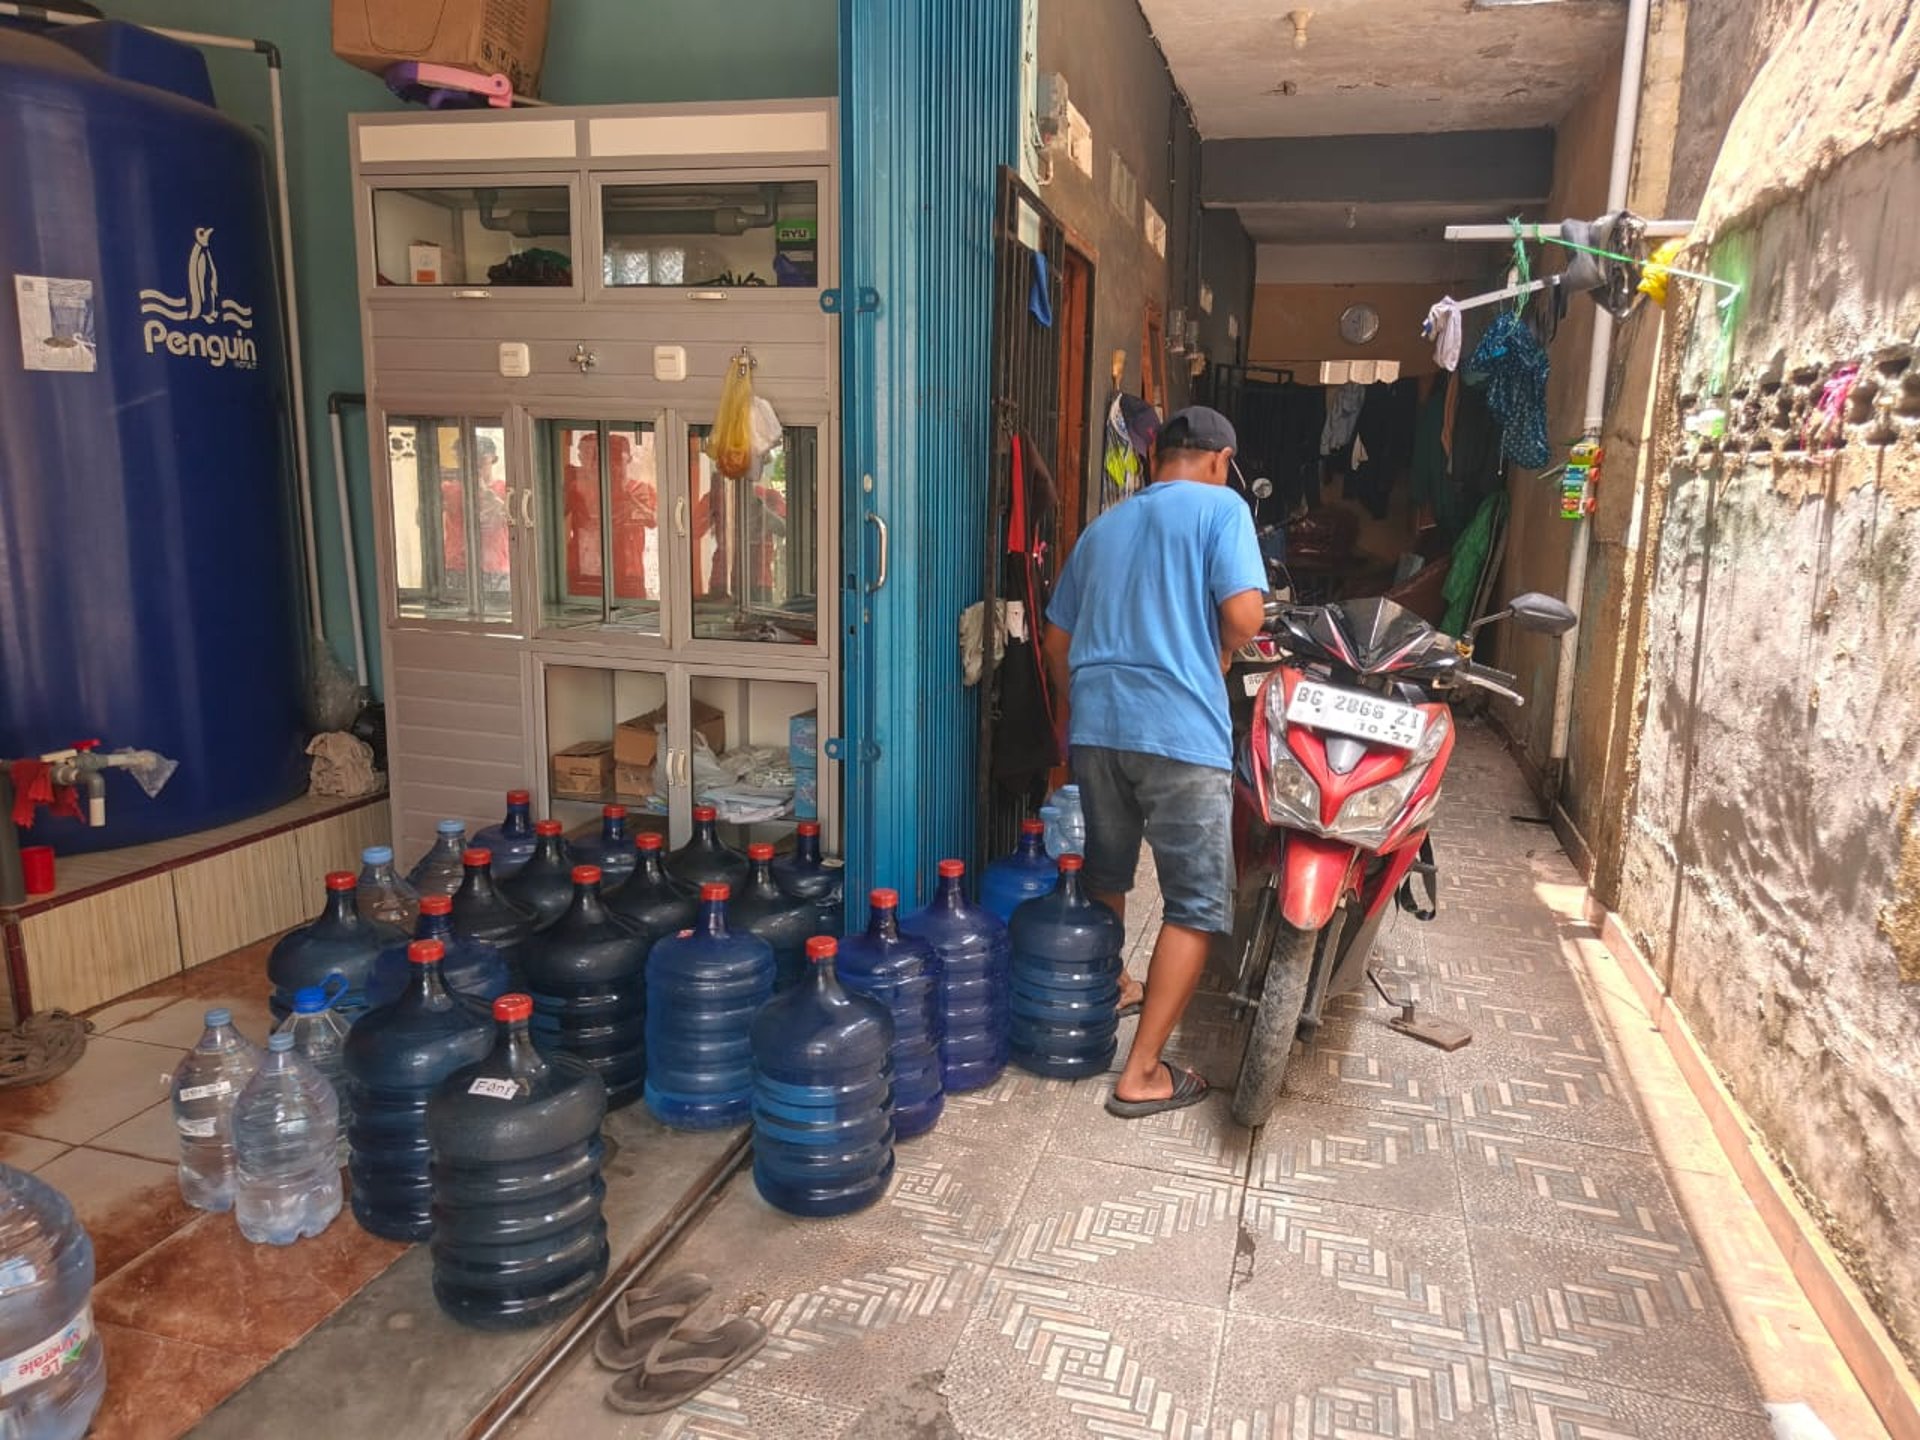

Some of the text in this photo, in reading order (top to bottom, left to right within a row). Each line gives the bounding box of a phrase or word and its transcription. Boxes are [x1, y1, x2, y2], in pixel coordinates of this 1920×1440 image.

[144, 320, 257, 367] Penguin
[1297, 686, 1324, 706] BG
[41, 1359, 61, 1377] Le
